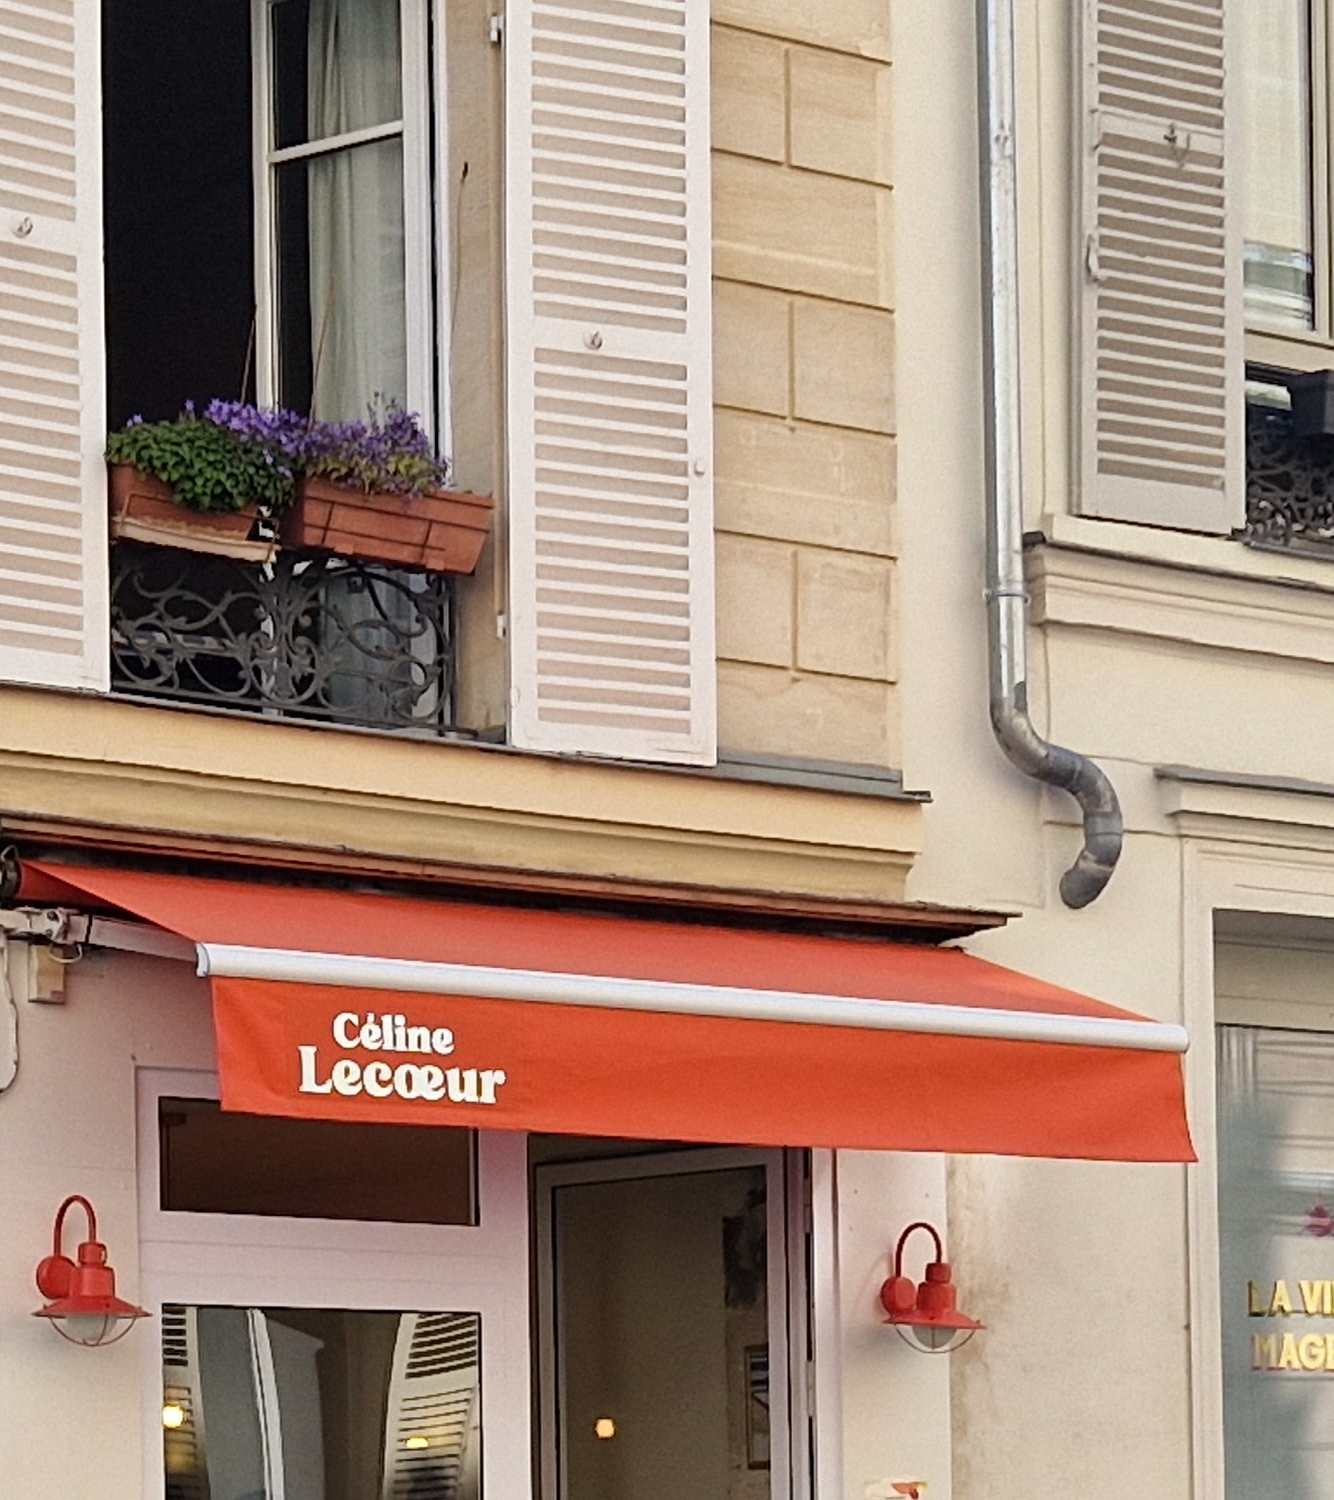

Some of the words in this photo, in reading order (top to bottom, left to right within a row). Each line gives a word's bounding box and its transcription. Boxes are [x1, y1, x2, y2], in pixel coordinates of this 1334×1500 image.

[332, 1012, 455, 1055] Céline
[298, 1045, 507, 1104] Lecœur
[1247, 1279, 1293, 1317] LA
